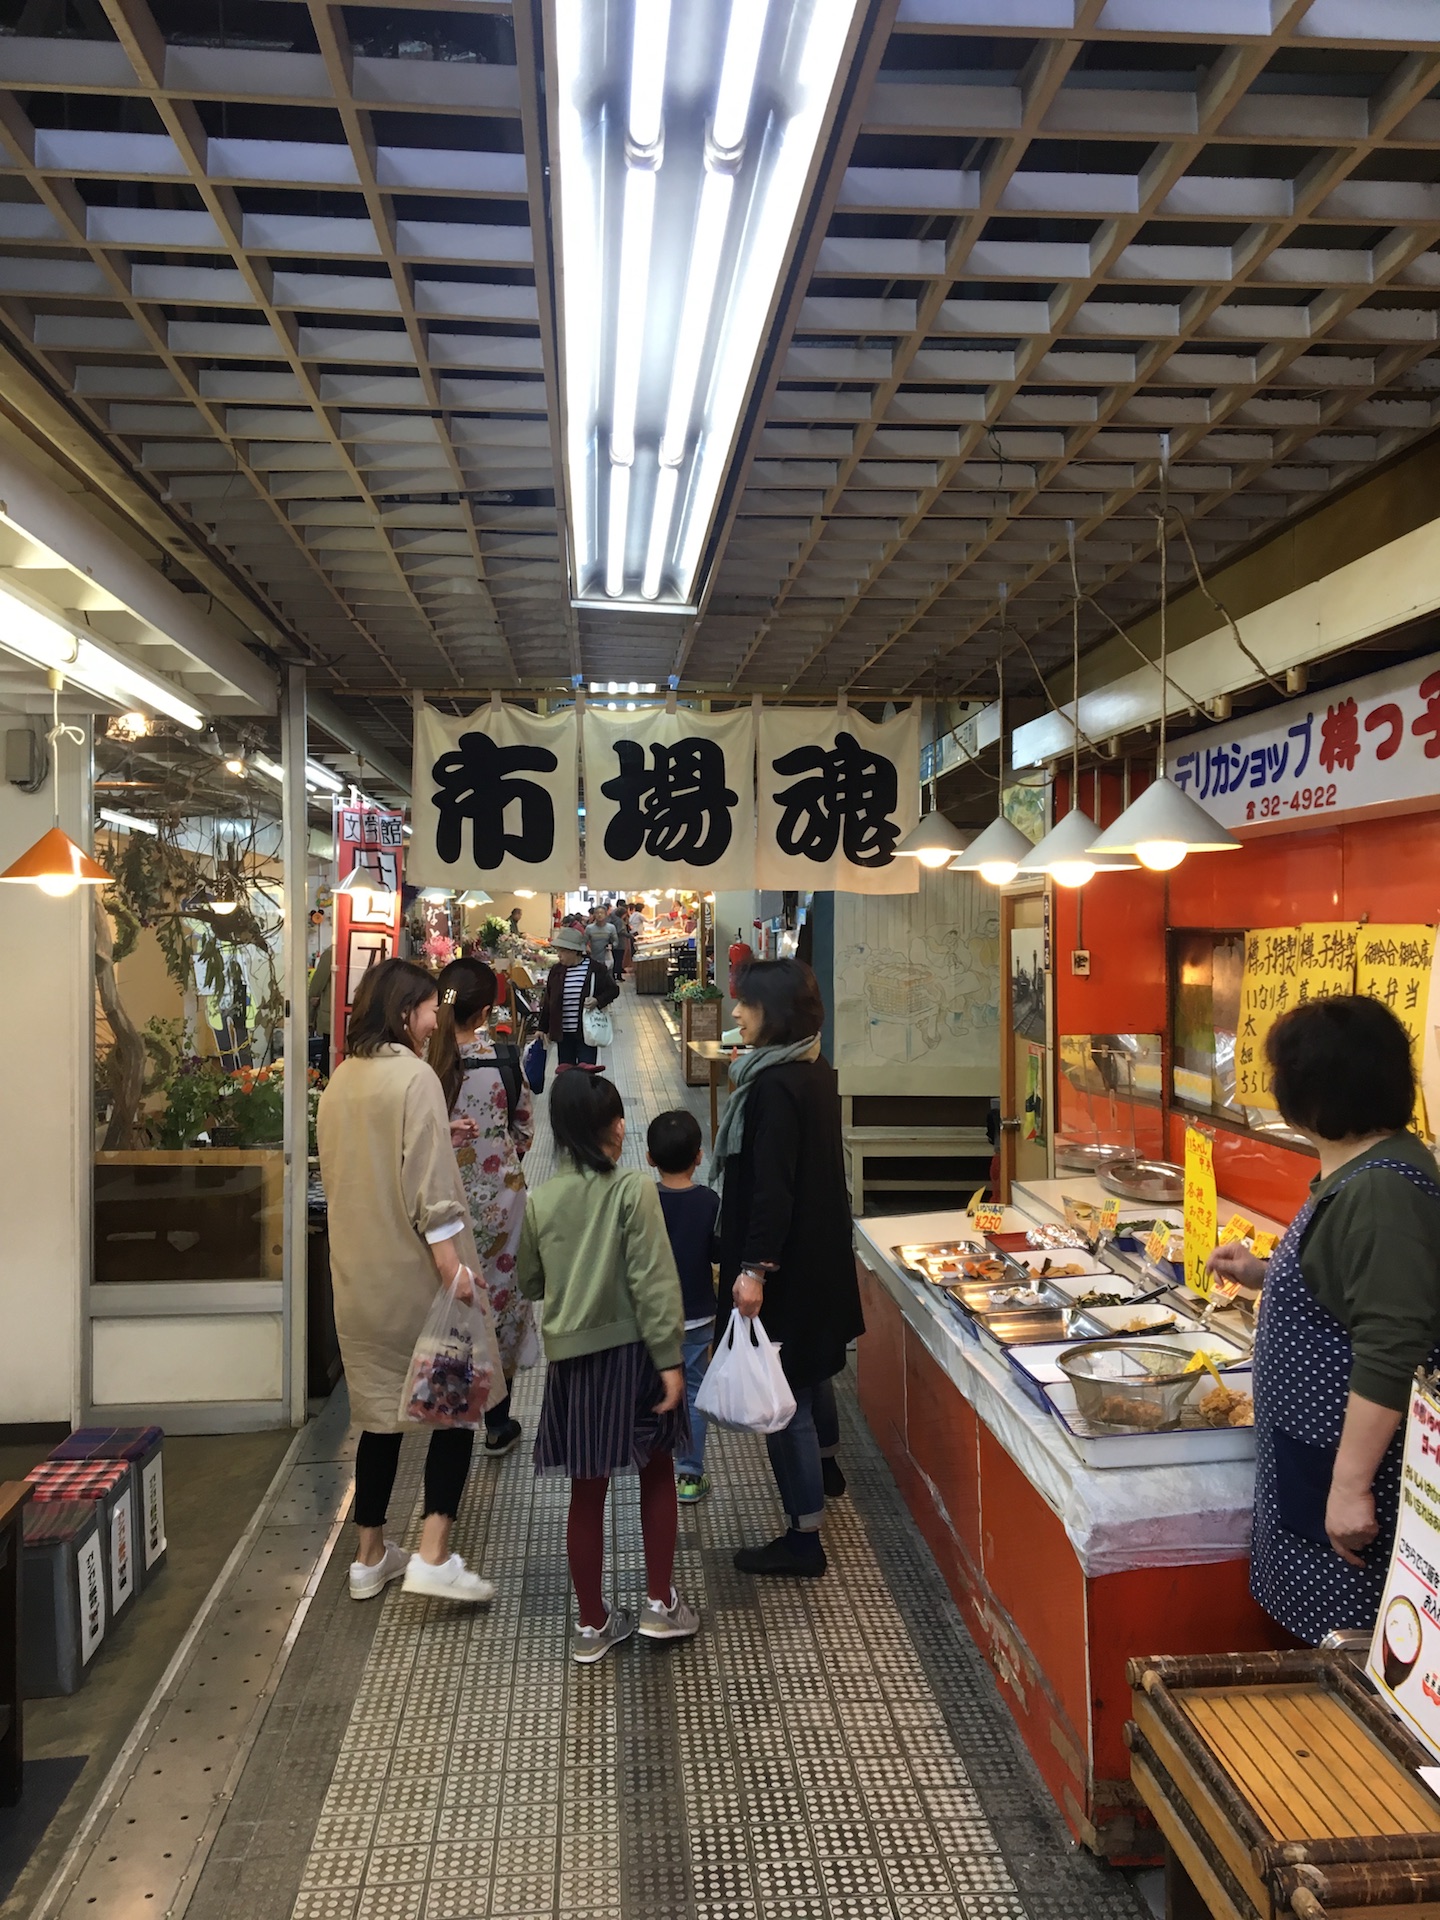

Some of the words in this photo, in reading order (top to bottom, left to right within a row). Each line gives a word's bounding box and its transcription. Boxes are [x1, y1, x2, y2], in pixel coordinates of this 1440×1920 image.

[1174, 712, 1314, 800] デリカショップ
[432, 731, 901, 869] 市場魂
[1260, 784, 1337, 817] 32-4922
[345, 813, 402, 845] 文学館
[975, 1214, 1002, 1230] ¥250
